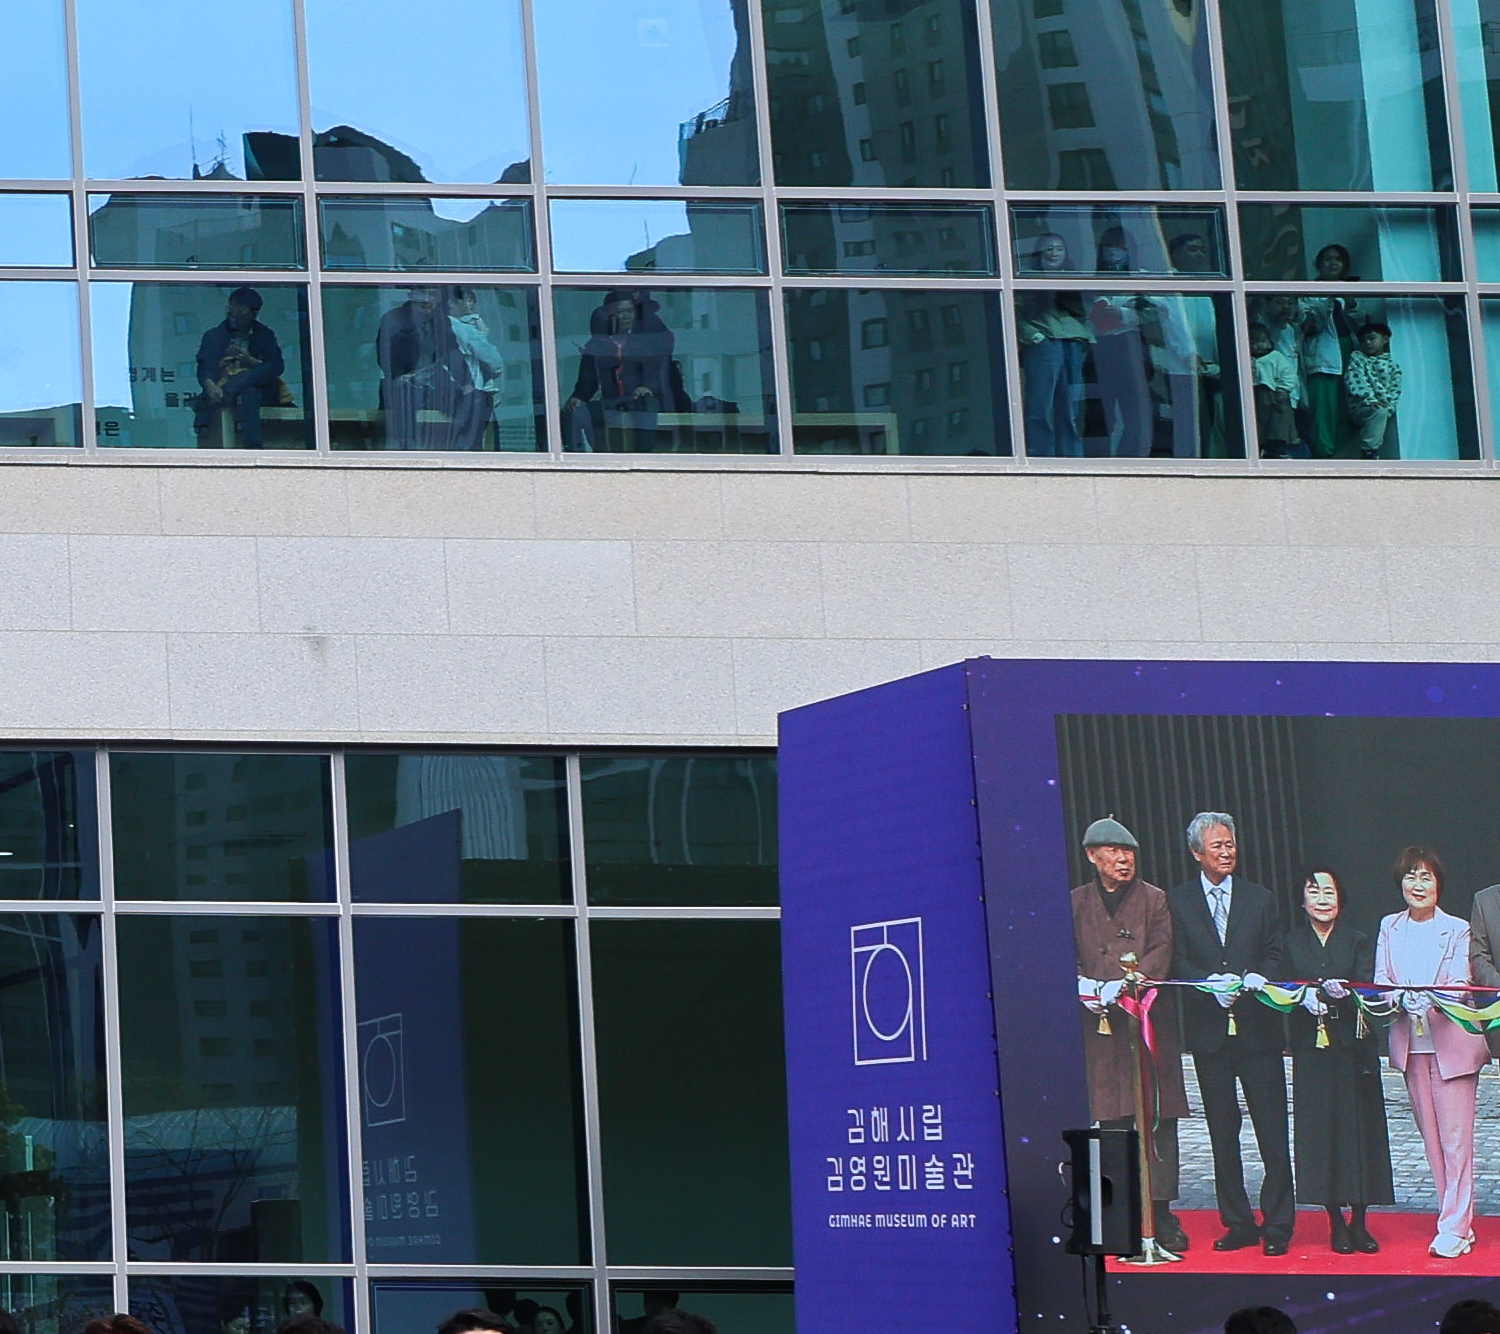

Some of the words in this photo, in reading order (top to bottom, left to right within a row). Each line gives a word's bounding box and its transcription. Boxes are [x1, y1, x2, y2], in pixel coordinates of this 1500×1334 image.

[847, 1104, 943, 1144] 김해시립
[826, 1152, 975, 1192] 김영원미술관
[828, 1214, 873, 1228] GIMHAE
[875, 1214, 928, 1228] MUSEUM
[931, 1214, 948, 1228] OF
[951, 1213, 977, 1228] ART
